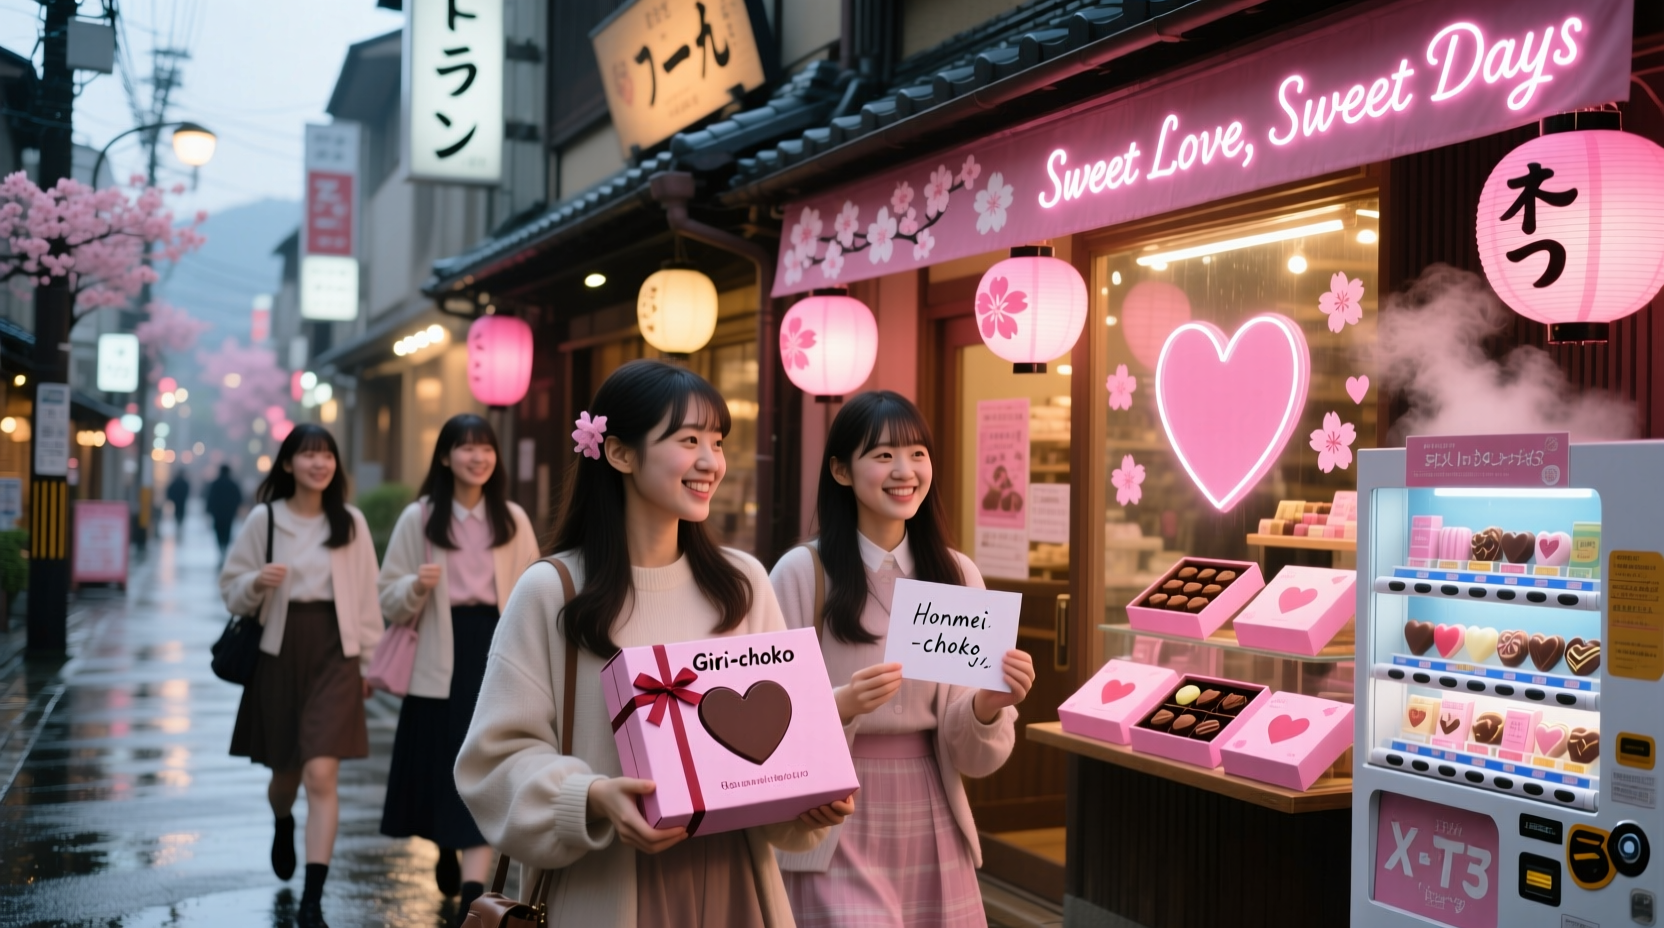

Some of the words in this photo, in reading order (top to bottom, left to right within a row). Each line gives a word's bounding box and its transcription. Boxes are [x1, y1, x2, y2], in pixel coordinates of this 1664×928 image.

[1038, 141, 1141, 208] Sweet
[1147, 114, 1254, 180] Love,
[1268, 59, 1415, 146] Sweet
[1426, 17, 1583, 110] Days
[692, 645, 795, 671] Giri-choko
[1384, 821, 1492, 900] X-T3
